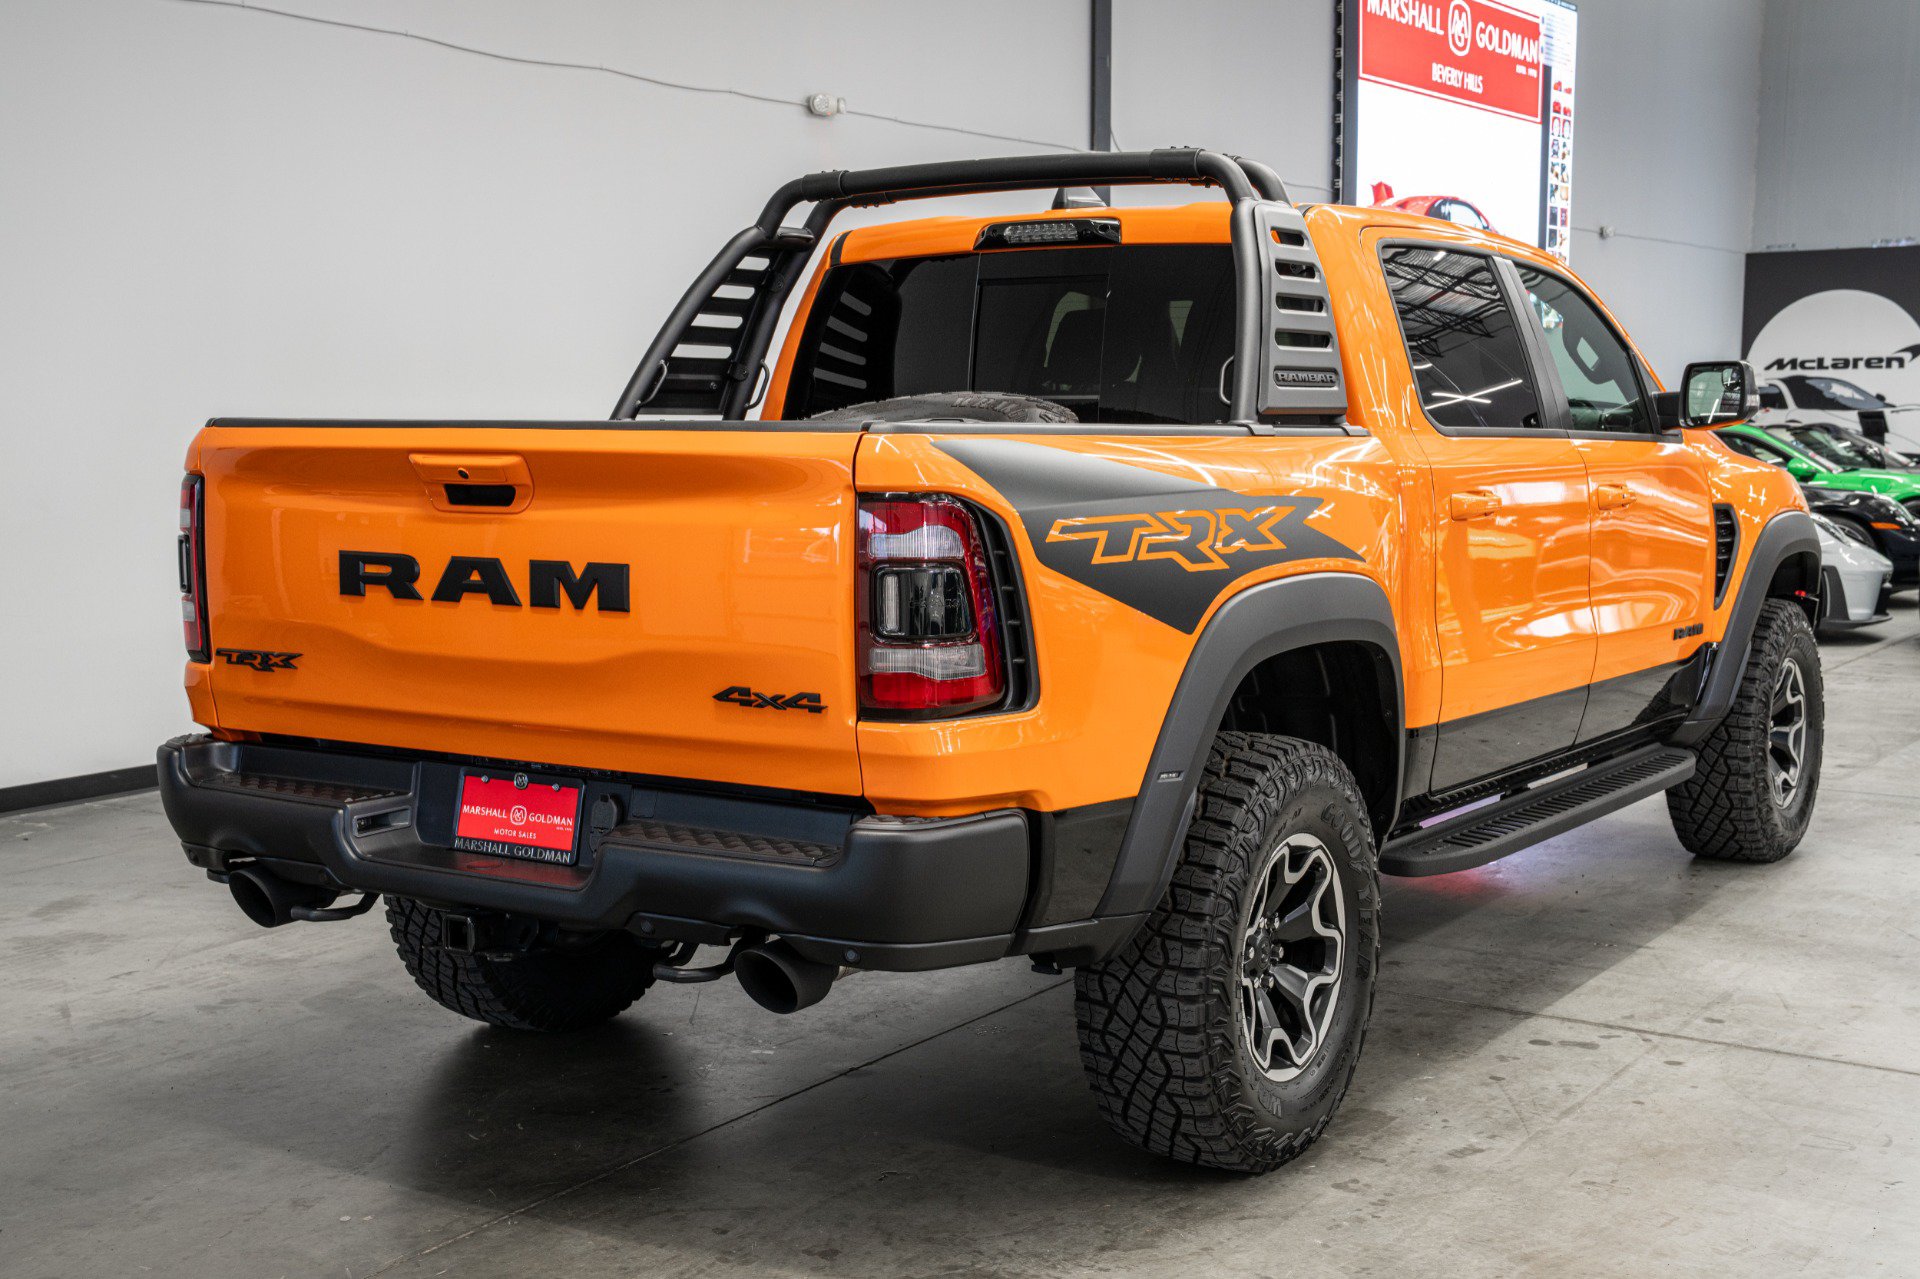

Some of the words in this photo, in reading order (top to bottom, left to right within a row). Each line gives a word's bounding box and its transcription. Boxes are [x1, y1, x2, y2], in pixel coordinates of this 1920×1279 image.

[1367, 0, 1444, 35] MARSHALL
[1476, 21, 1538, 64] GOLDMAN
[1431, 62, 1463, 88] BEVERLY
[1463, 71, 1484, 94] HILLS
[1764, 356, 1905, 371] McLaren
[1277, 372, 1336, 383] RAMBAR
[1045, 506, 1297, 572] TRX
[339, 550, 631, 613] RAM
[216, 647, 304, 672] TRX
[463, 804, 508, 819] MARSHALL
[529, 814, 573, 826] GOLDMAN
[494, 828, 517, 837] MOTOR
[518, 831, 537, 840] SALES
[454, 837, 511, 856] MARSHALL
[514, 845, 571, 863] GOLDMAN
[1320, 801, 1373, 980] GOODYEAR
